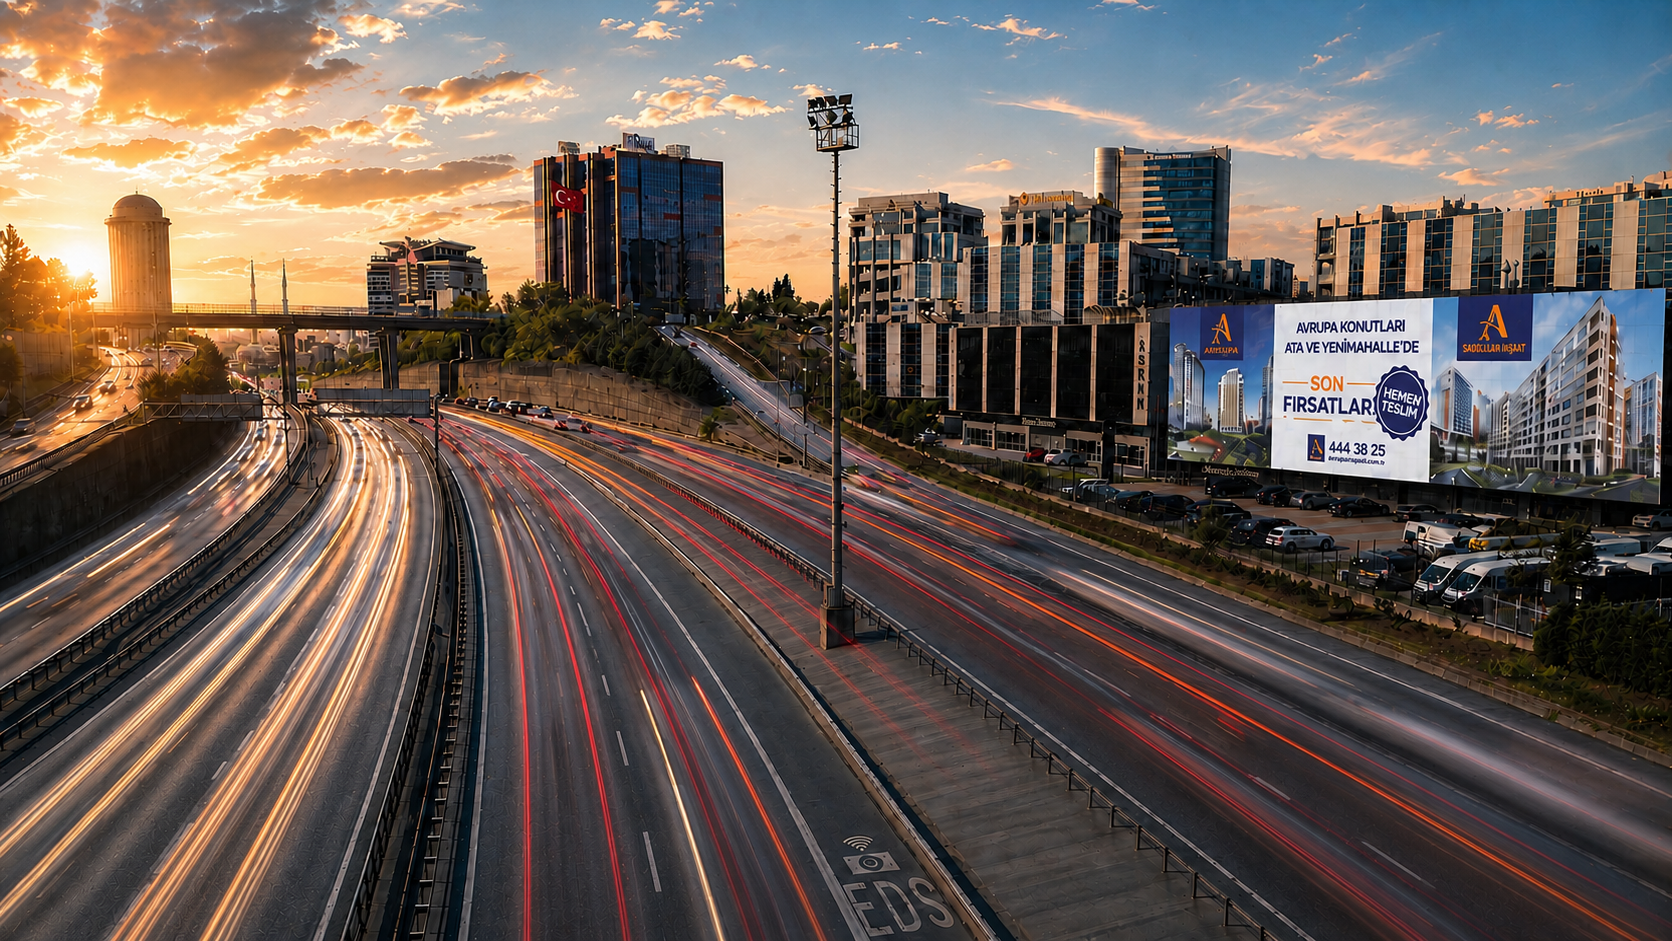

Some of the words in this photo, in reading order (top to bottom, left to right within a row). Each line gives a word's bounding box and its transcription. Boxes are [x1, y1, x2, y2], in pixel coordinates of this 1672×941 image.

[1296, 321, 1338, 334] AVRUPA
[1340, 319, 1406, 333] KONUTLARI
[1284, 341, 1304, 354] ATA
[1306, 341, 1320, 353] VE
[1310, 375, 1344, 392] SON
[1383, 386, 1422, 407] HEMEN
[1283, 395, 1376, 416] FIRSATLAR
[1328, 440, 1351, 454] 444
[1353, 442, 1368, 456] 38
[1370, 443, 1386, 457] 25
[842, 876, 955, 937] EDS
